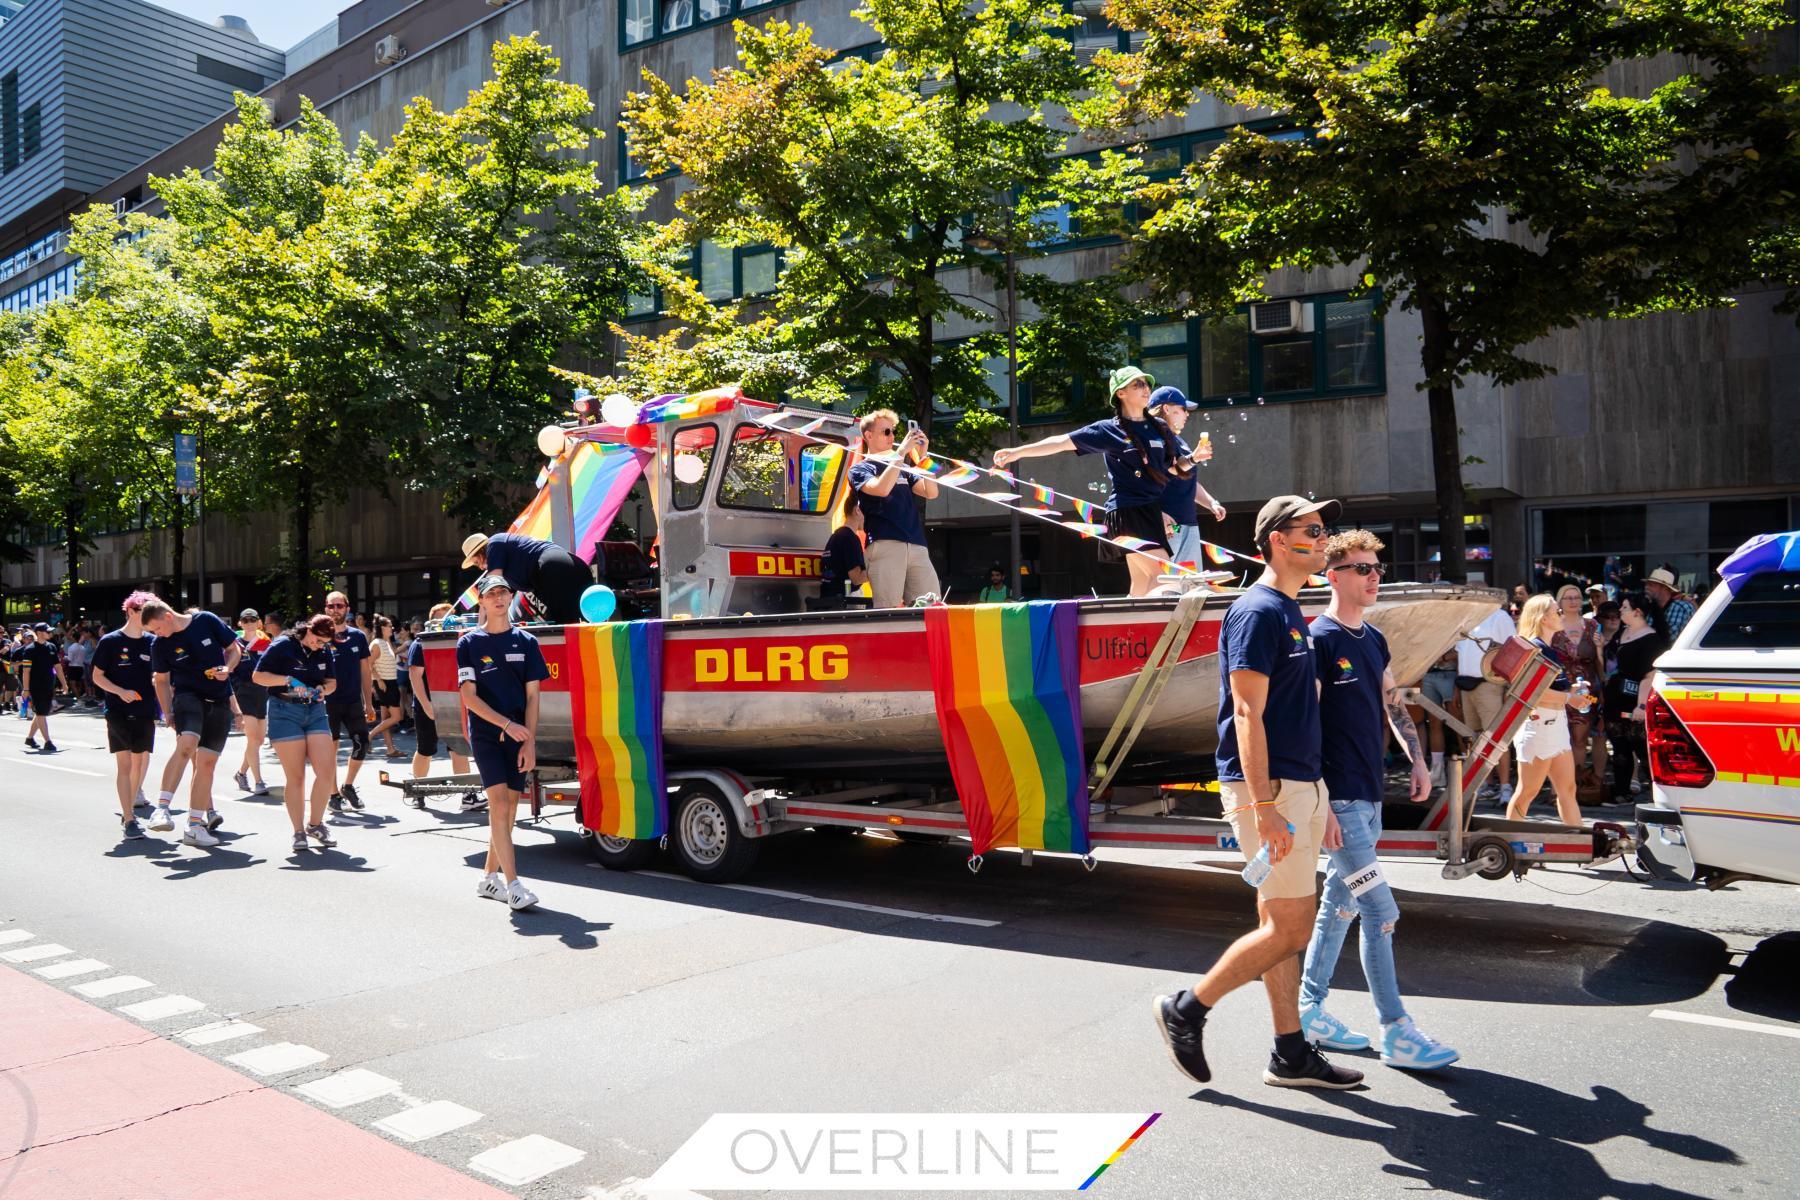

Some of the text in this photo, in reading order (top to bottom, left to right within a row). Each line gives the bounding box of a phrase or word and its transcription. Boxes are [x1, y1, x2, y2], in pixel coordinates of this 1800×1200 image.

[1086, 636, 1148, 660] Ulfrid
[695, 644, 849, 683] DLRG
[1776, 727, 1800, 753] W
